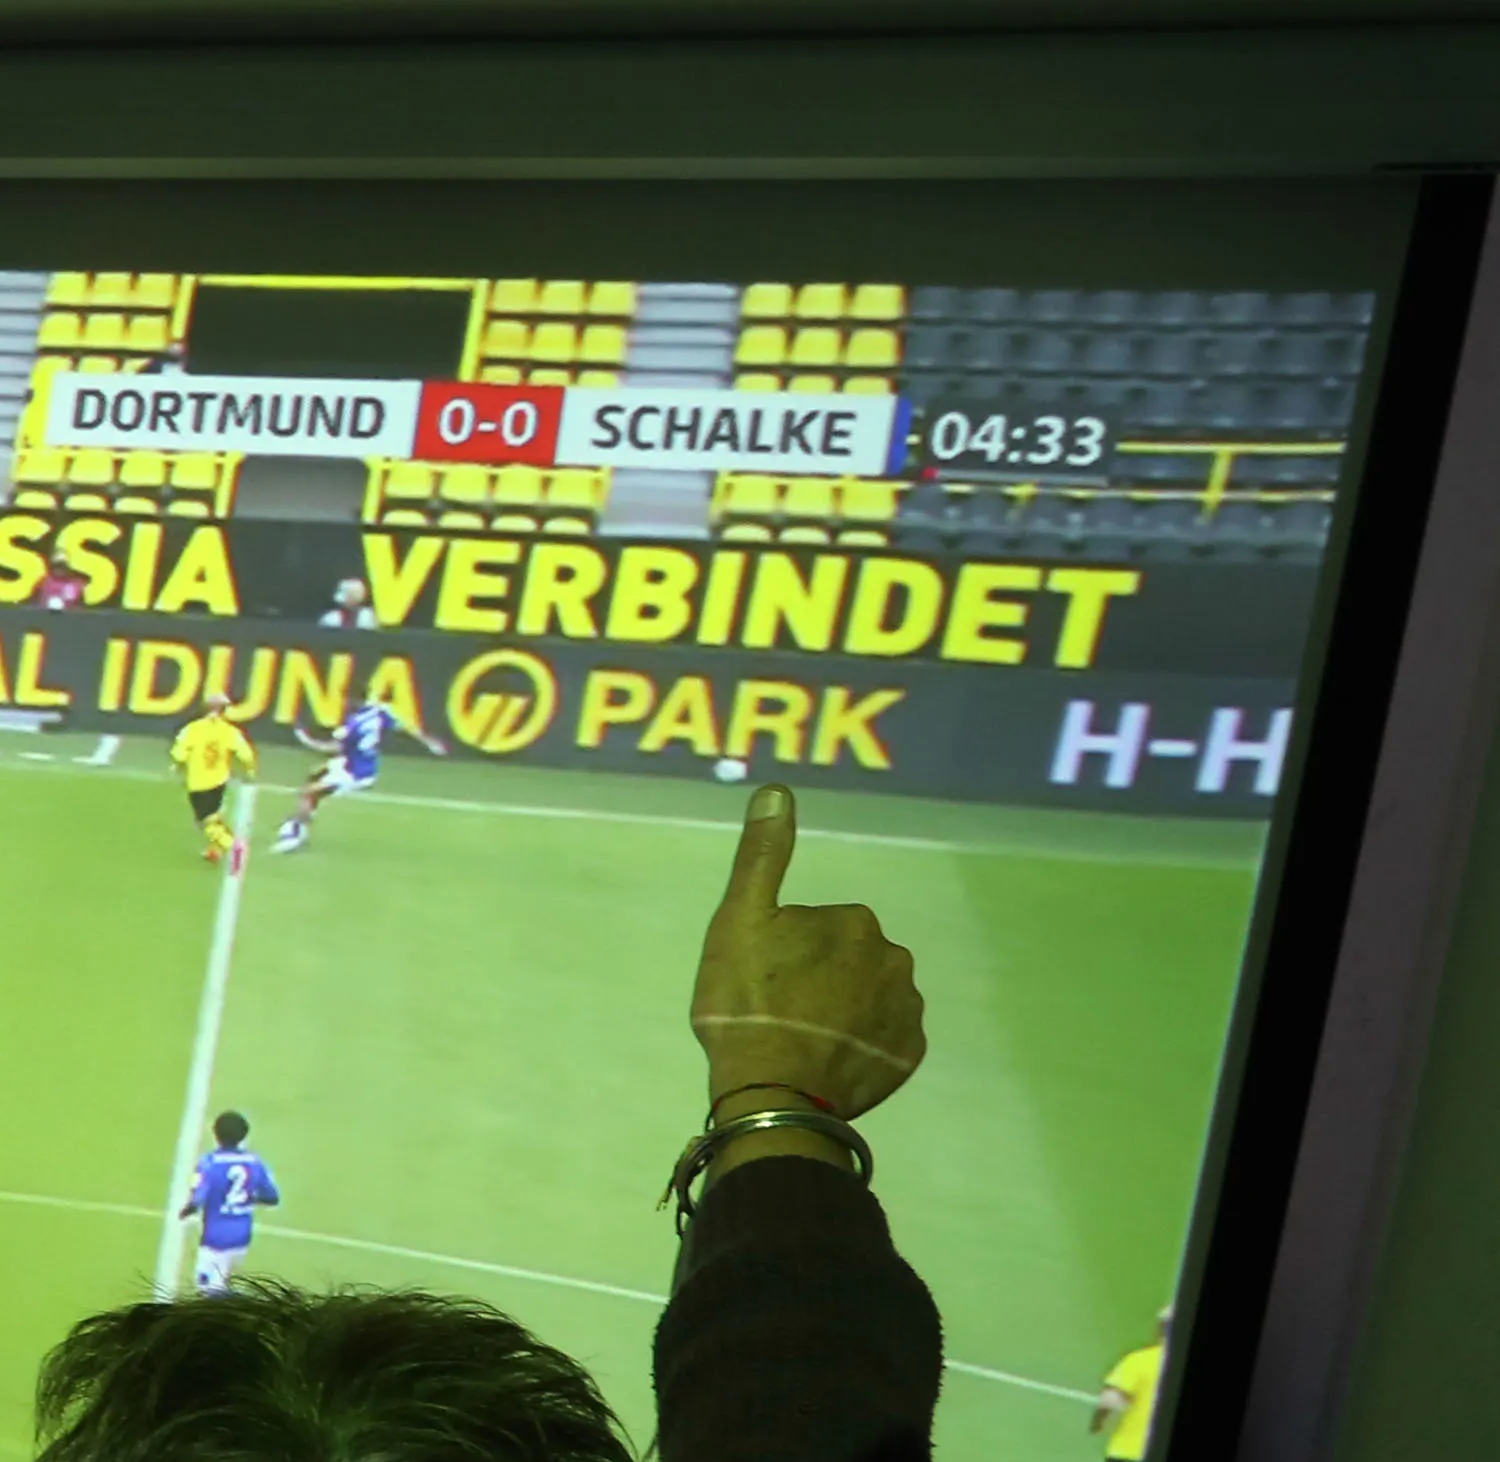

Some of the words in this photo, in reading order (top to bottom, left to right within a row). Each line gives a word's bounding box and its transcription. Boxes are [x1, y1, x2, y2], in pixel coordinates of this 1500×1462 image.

[72, 388, 386, 441] DORTMUND
[437, 398, 538, 448] 0-0
[590, 404, 857, 457] SCHALKE
[929, 410, 1107, 468] 04:33
[361, 532, 1142, 670] VERBINDET
[97, 637, 424, 728] IDUNA
[574, 668, 906, 770] PARK
[226, 1165, 248, 1204] 2
